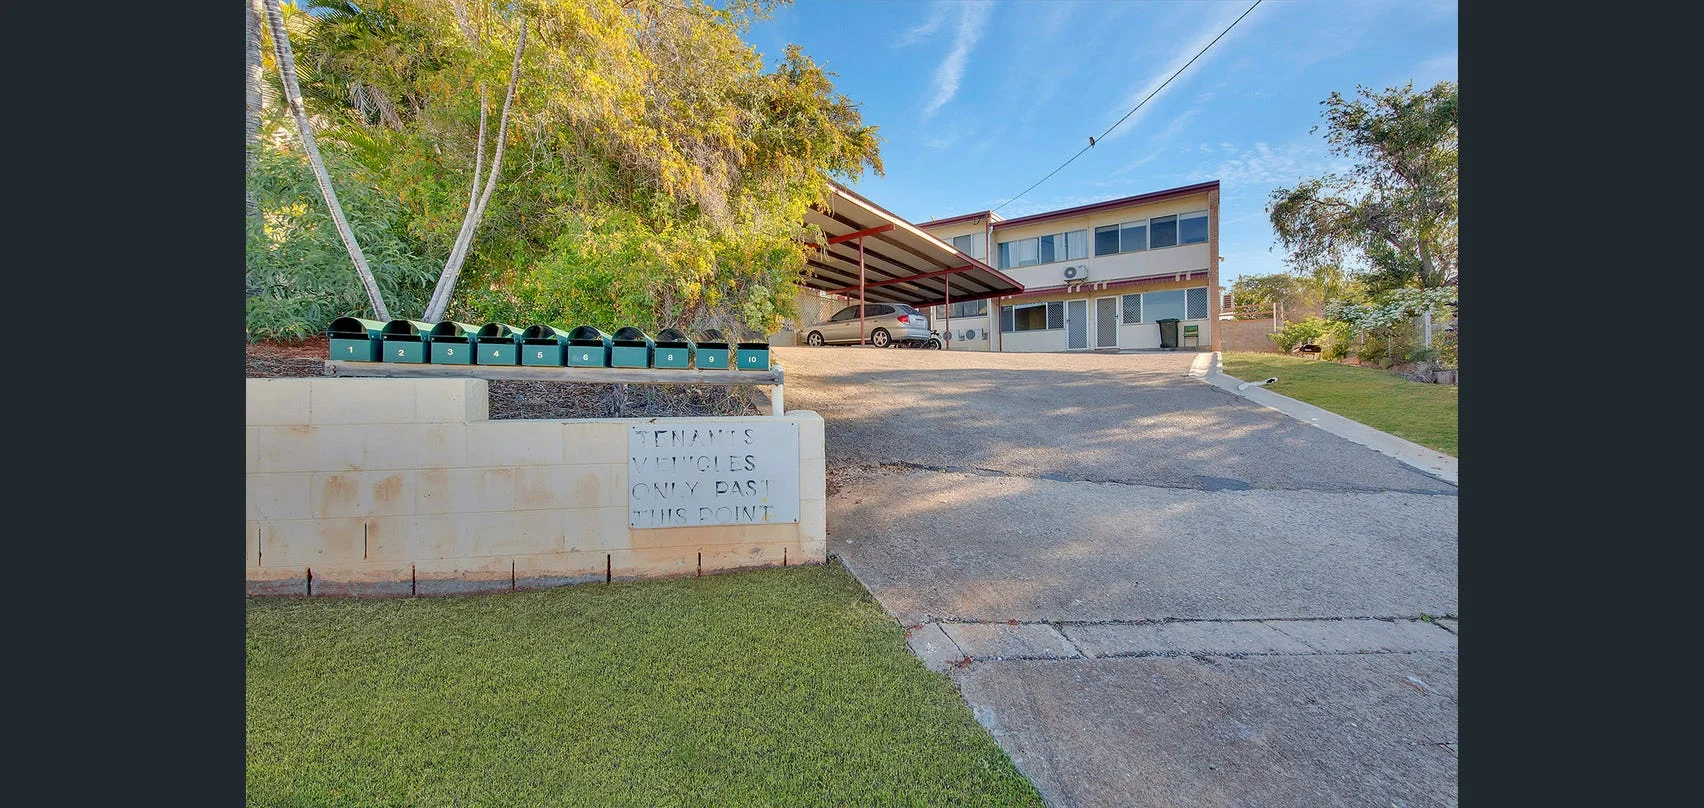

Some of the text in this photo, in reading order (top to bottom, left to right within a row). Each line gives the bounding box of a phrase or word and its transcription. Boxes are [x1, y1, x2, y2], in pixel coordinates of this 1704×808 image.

[347, 346, 353, 354] 1
[398, 349, 405, 357] 2
[447, 348, 454, 356] 3
[537, 351, 544, 359] 5
[582, 353, 589, 361] 6
[667, 354, 674, 362] 8
[708, 355, 715, 363] 9
[715, 479, 774, 497] PAST
[699, 505, 774, 523] POINT
